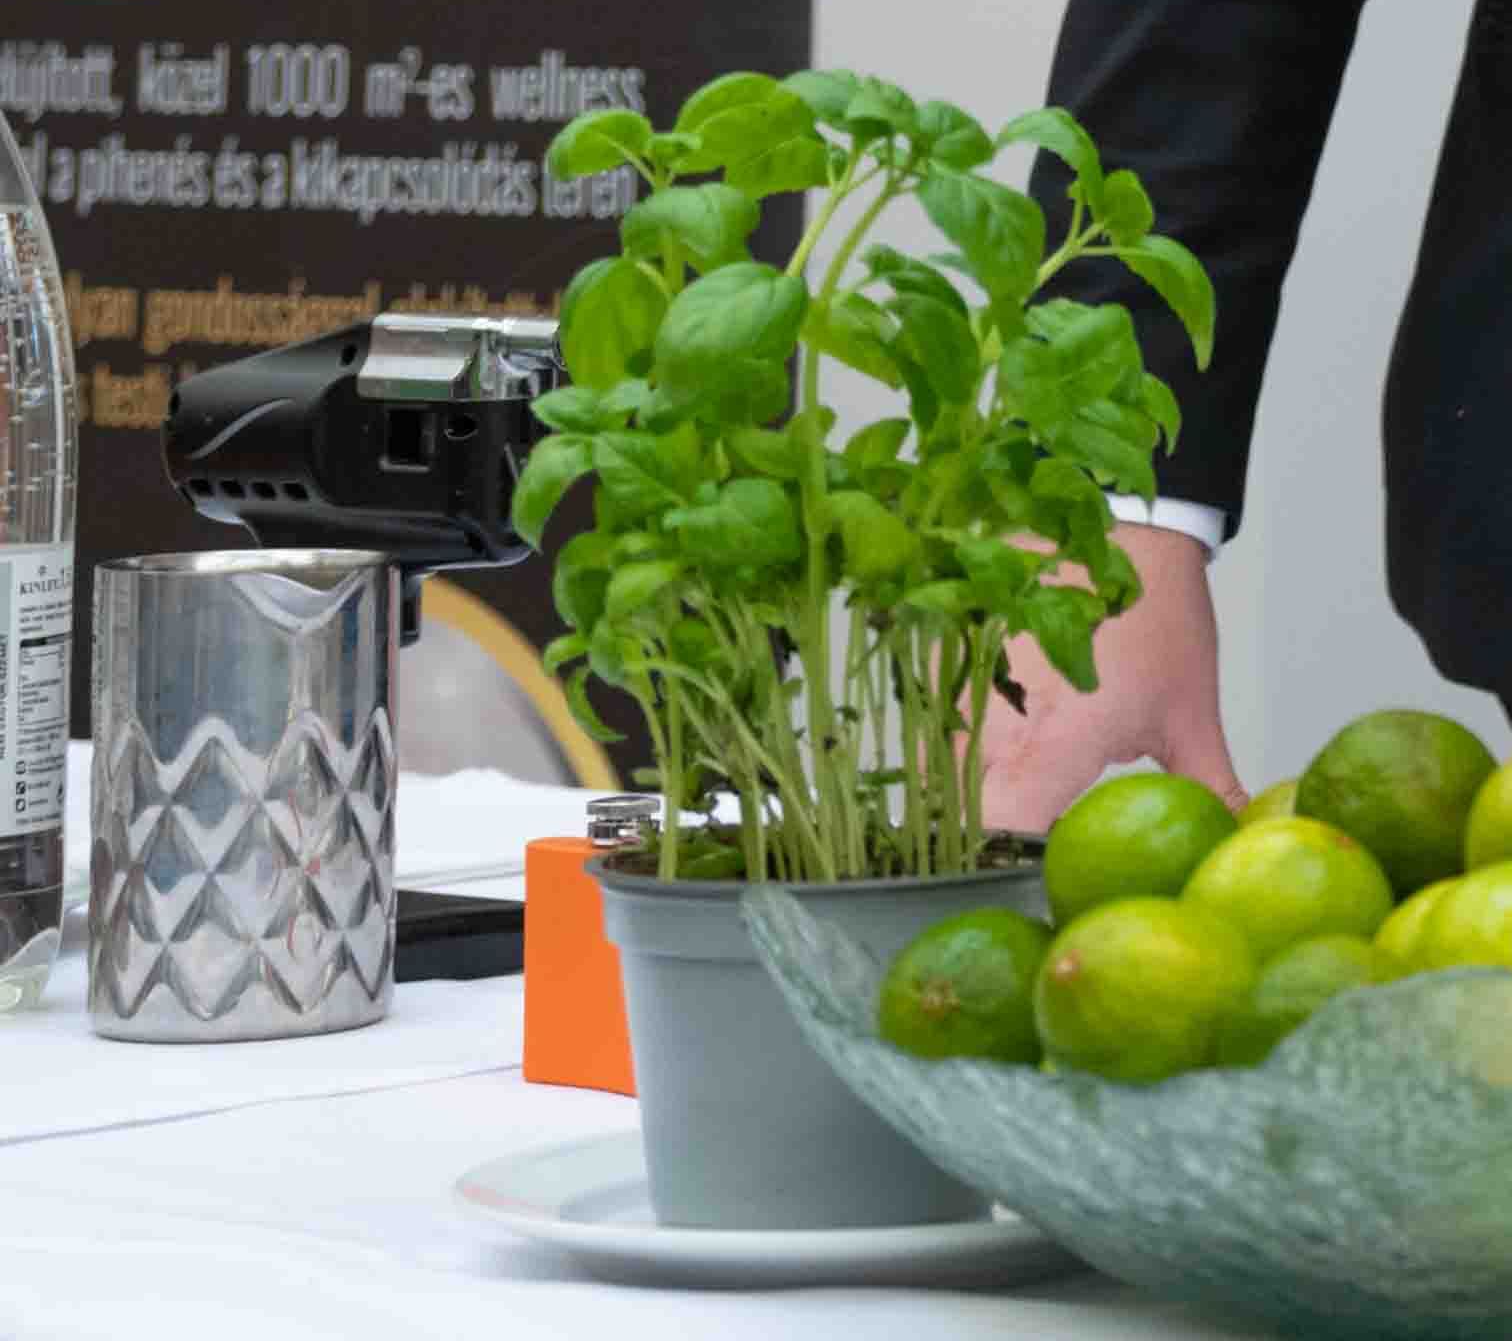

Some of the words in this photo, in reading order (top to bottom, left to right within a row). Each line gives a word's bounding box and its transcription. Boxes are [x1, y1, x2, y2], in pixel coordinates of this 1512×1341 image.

[138, 41, 229, 116] közel
[247, 42, 350, 119] 1000
[490, 49, 646, 121] wellness
[261, 151, 289, 210] a
